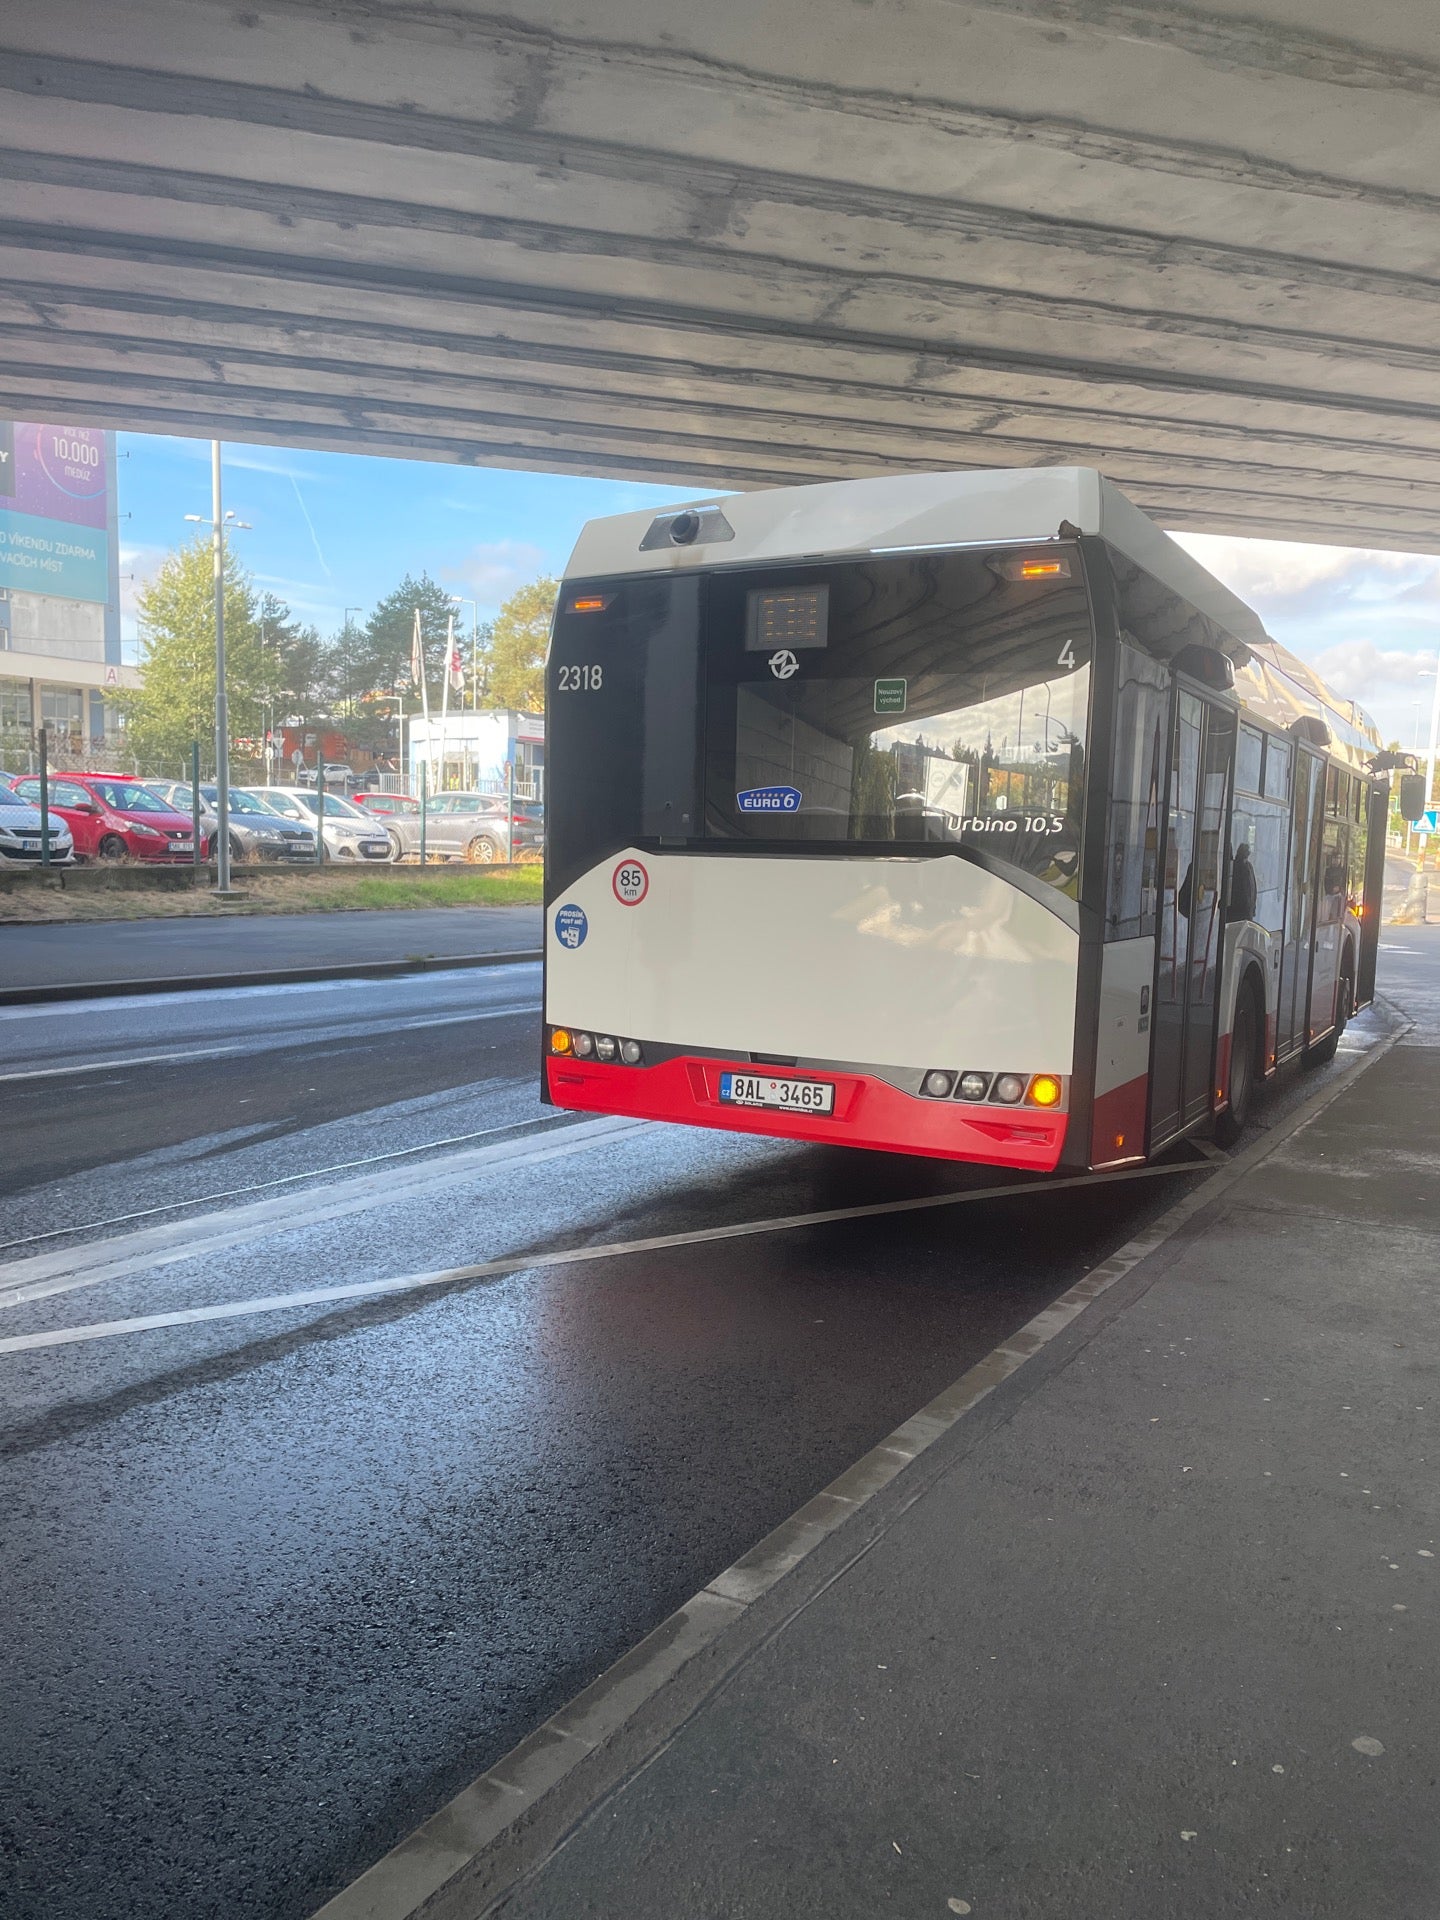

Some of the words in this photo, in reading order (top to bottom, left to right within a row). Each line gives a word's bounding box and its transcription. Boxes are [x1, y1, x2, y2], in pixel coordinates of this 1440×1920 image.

[52, 436, 99, 467] 10.000
[55, 542, 96, 561] ZDARMA
[1058, 640, 1075, 669] 4
[107, 667, 117, 683] A
[558, 664, 603, 691] 2318
[744, 798, 781, 808] EURO
[783, 793, 796, 808] 6
[947, 816, 1018, 832] Urbino
[1024, 816, 1065, 836] 10,5
[620, 870, 641, 886] 85
[624, 887, 637, 896] km
[735, 1079, 765, 1100] 8AL
[780, 1084, 823, 1106] 3465
